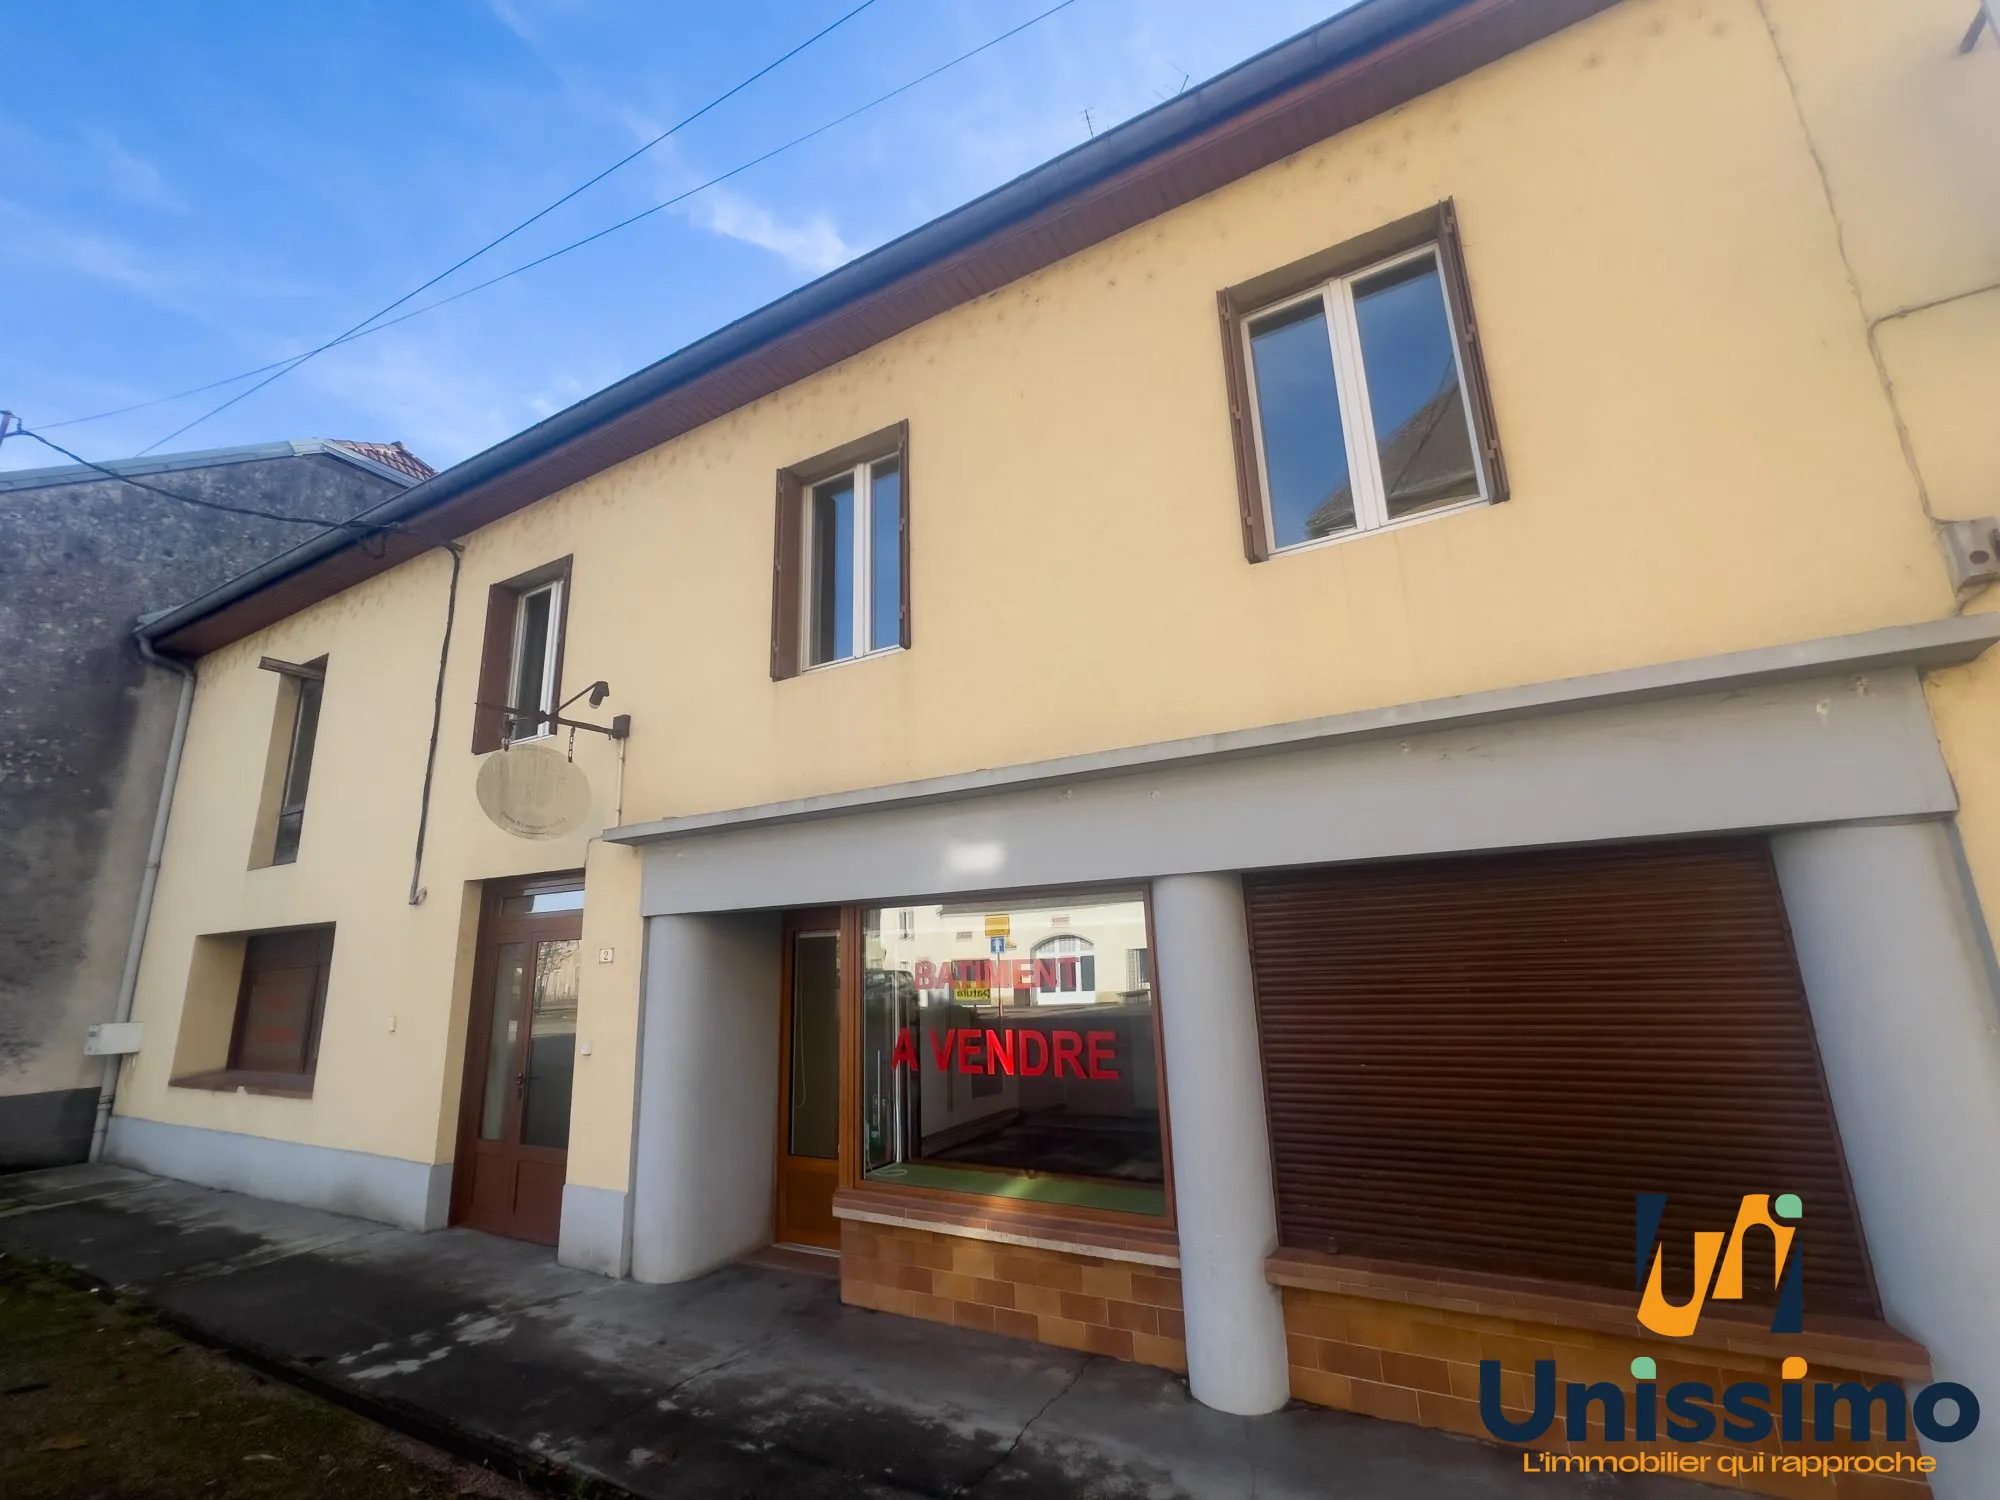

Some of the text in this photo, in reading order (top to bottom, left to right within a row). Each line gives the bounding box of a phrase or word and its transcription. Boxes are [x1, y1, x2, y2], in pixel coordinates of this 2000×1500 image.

[914, 956, 1079, 990] BATIMENT
[891, 1028, 1120, 1080] A VENDRE
